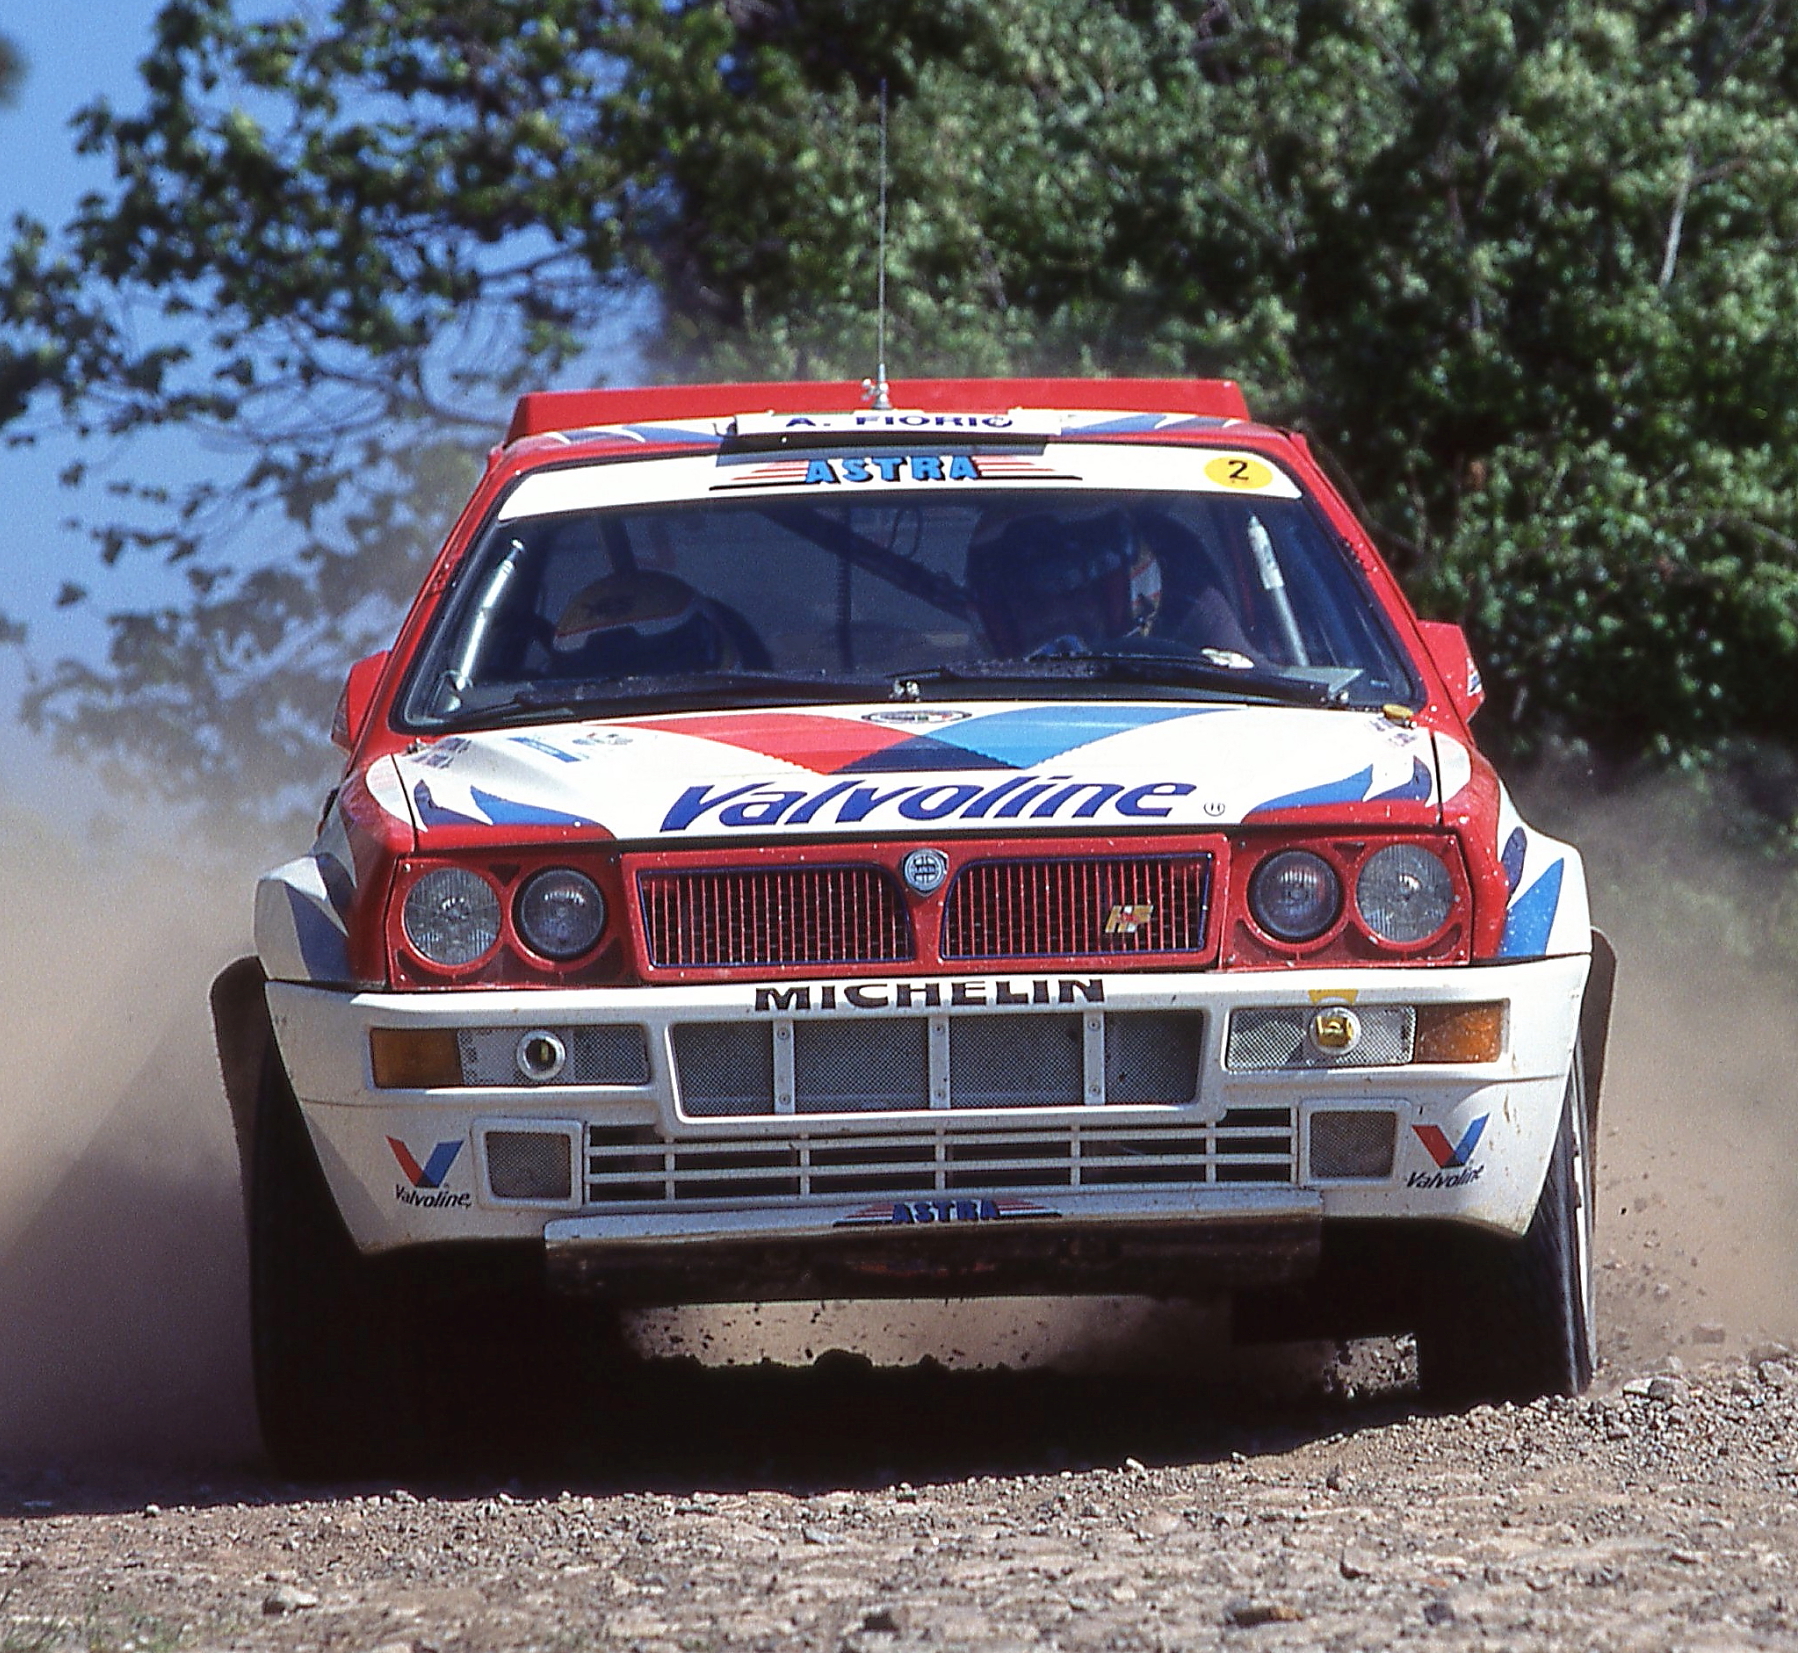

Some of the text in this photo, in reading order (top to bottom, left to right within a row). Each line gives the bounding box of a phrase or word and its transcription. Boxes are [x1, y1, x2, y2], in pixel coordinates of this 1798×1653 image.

[785, 416, 831, 428] A.
[805, 455, 981, 485] ASTRA
[1228, 459, 1249, 481] 2
[660, 776, 1197, 832] Valvoline
[754, 978, 1105, 1011] MICHELIN
[394, 1183, 471, 1209] Valvoline
[892, 1199, 1001, 1224] ASTRA
